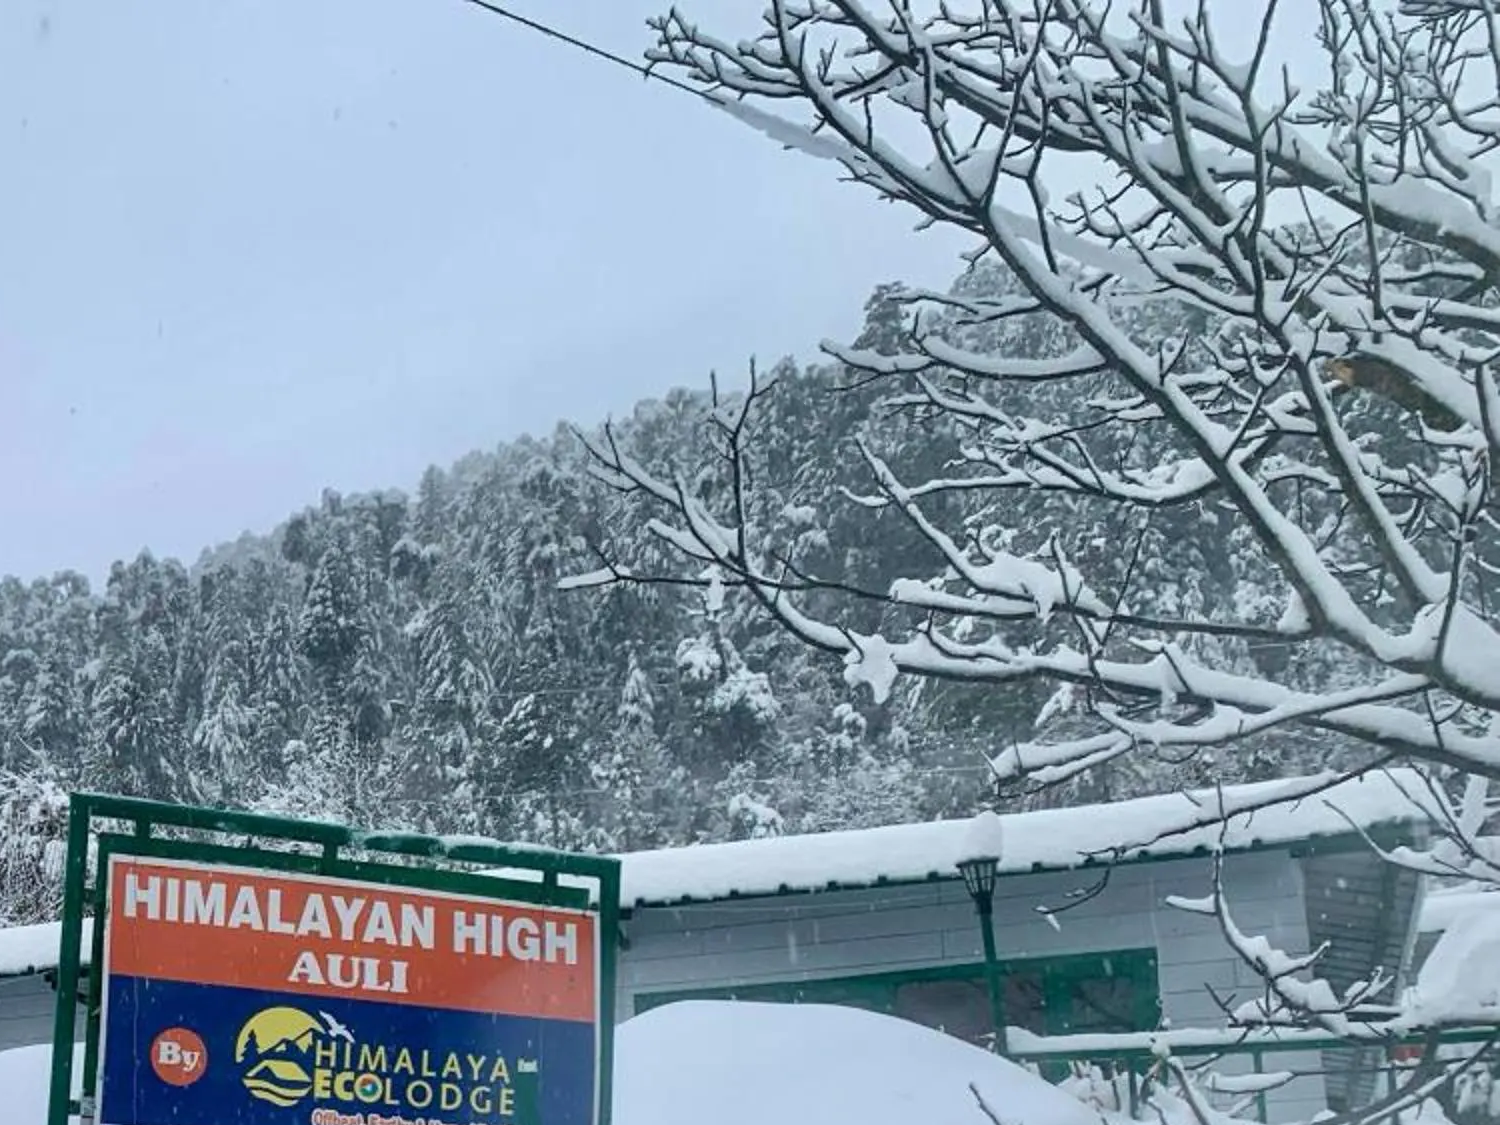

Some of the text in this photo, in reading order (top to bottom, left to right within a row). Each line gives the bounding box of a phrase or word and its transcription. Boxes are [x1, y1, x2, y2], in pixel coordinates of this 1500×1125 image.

[124, 872, 577, 965] HIMALAYAN HIGH
[287, 950, 408, 993] AULI
[158, 1040, 200, 1072] By
[315, 1039, 510, 1084] HIMALAYA
